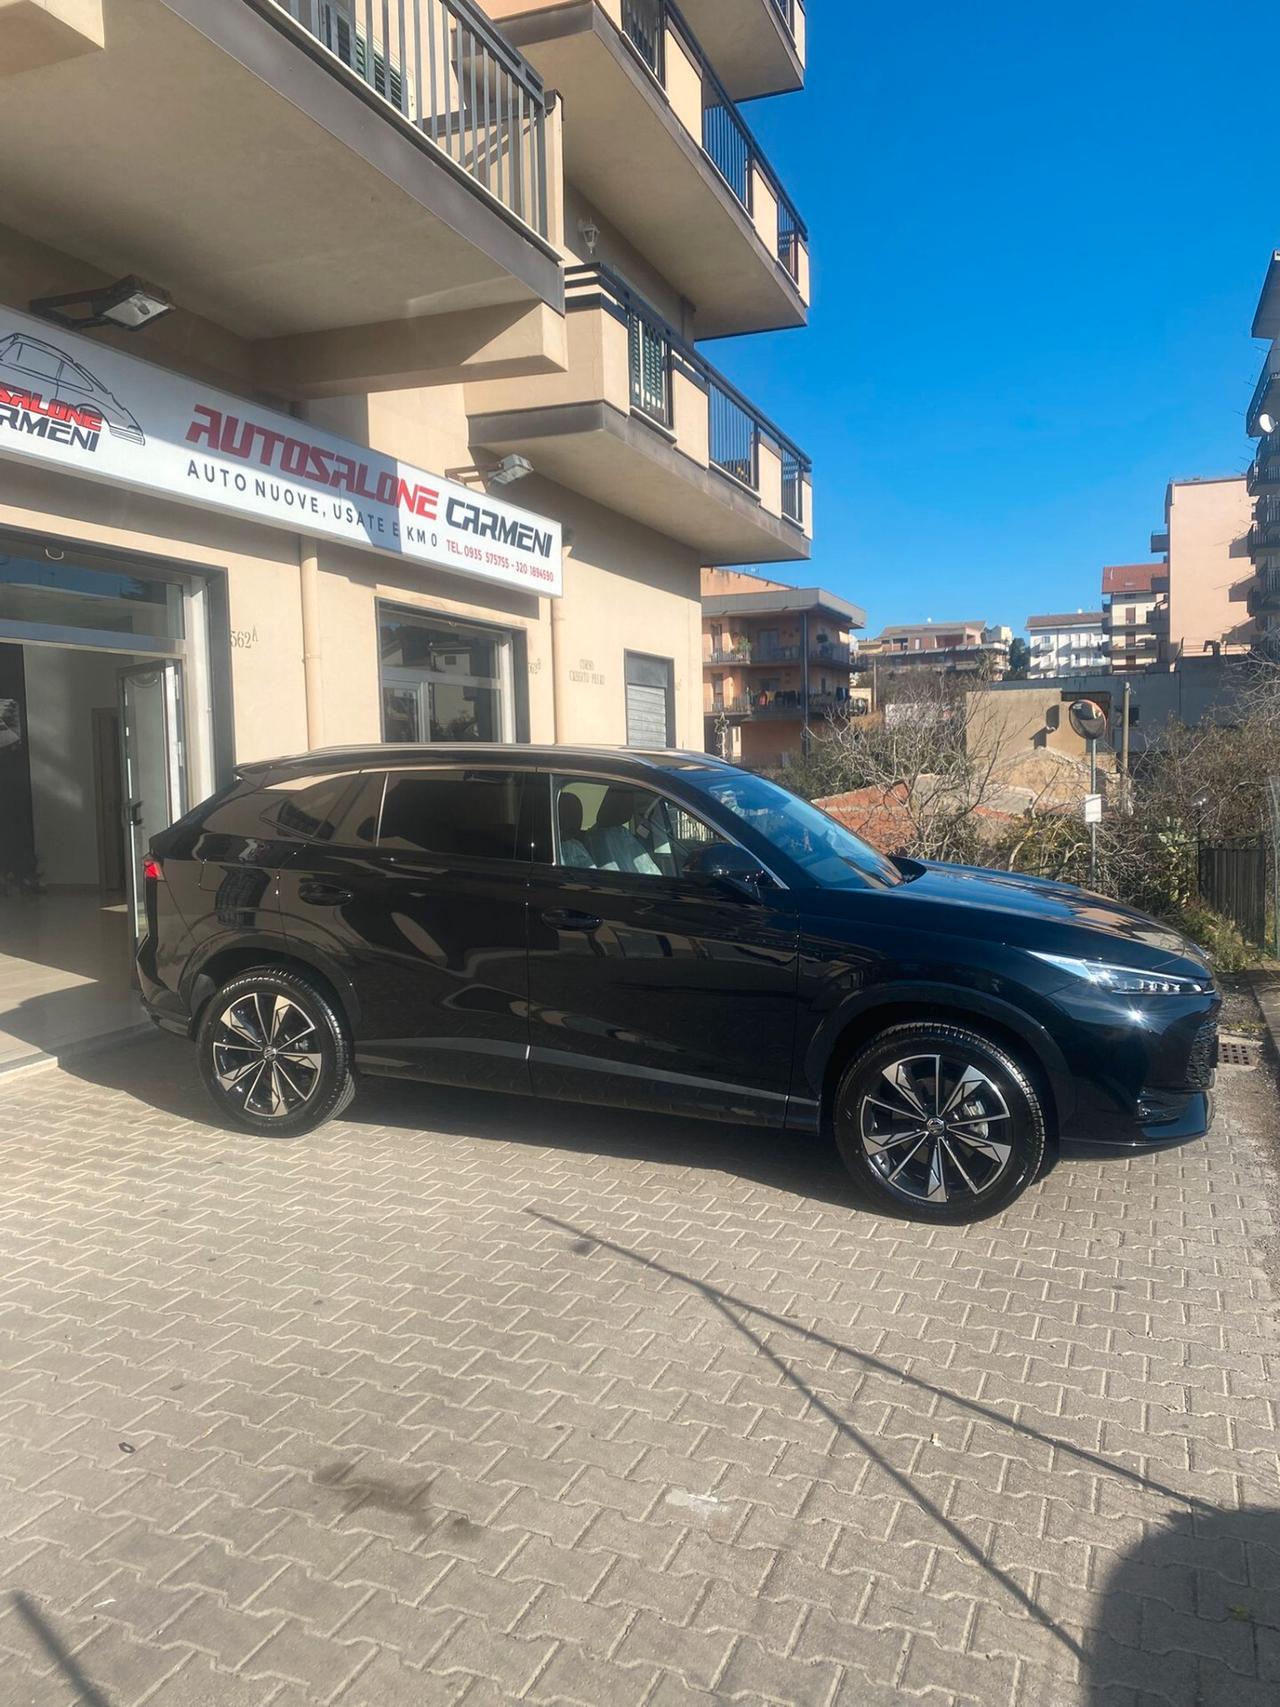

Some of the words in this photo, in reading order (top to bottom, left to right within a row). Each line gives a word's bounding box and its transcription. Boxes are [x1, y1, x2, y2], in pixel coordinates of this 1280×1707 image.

[185, 403, 439, 521] AUTOSALONE
[445, 496, 553, 558] CARMENI
[187, 459, 247, 492] AUTO
[254, 478, 326, 518] NUOVE,
[333, 503, 385, 533] USATE
[392, 521, 399, 537] E
[485, 551, 509, 569] 575755
[516, 561, 528, 575] 320
